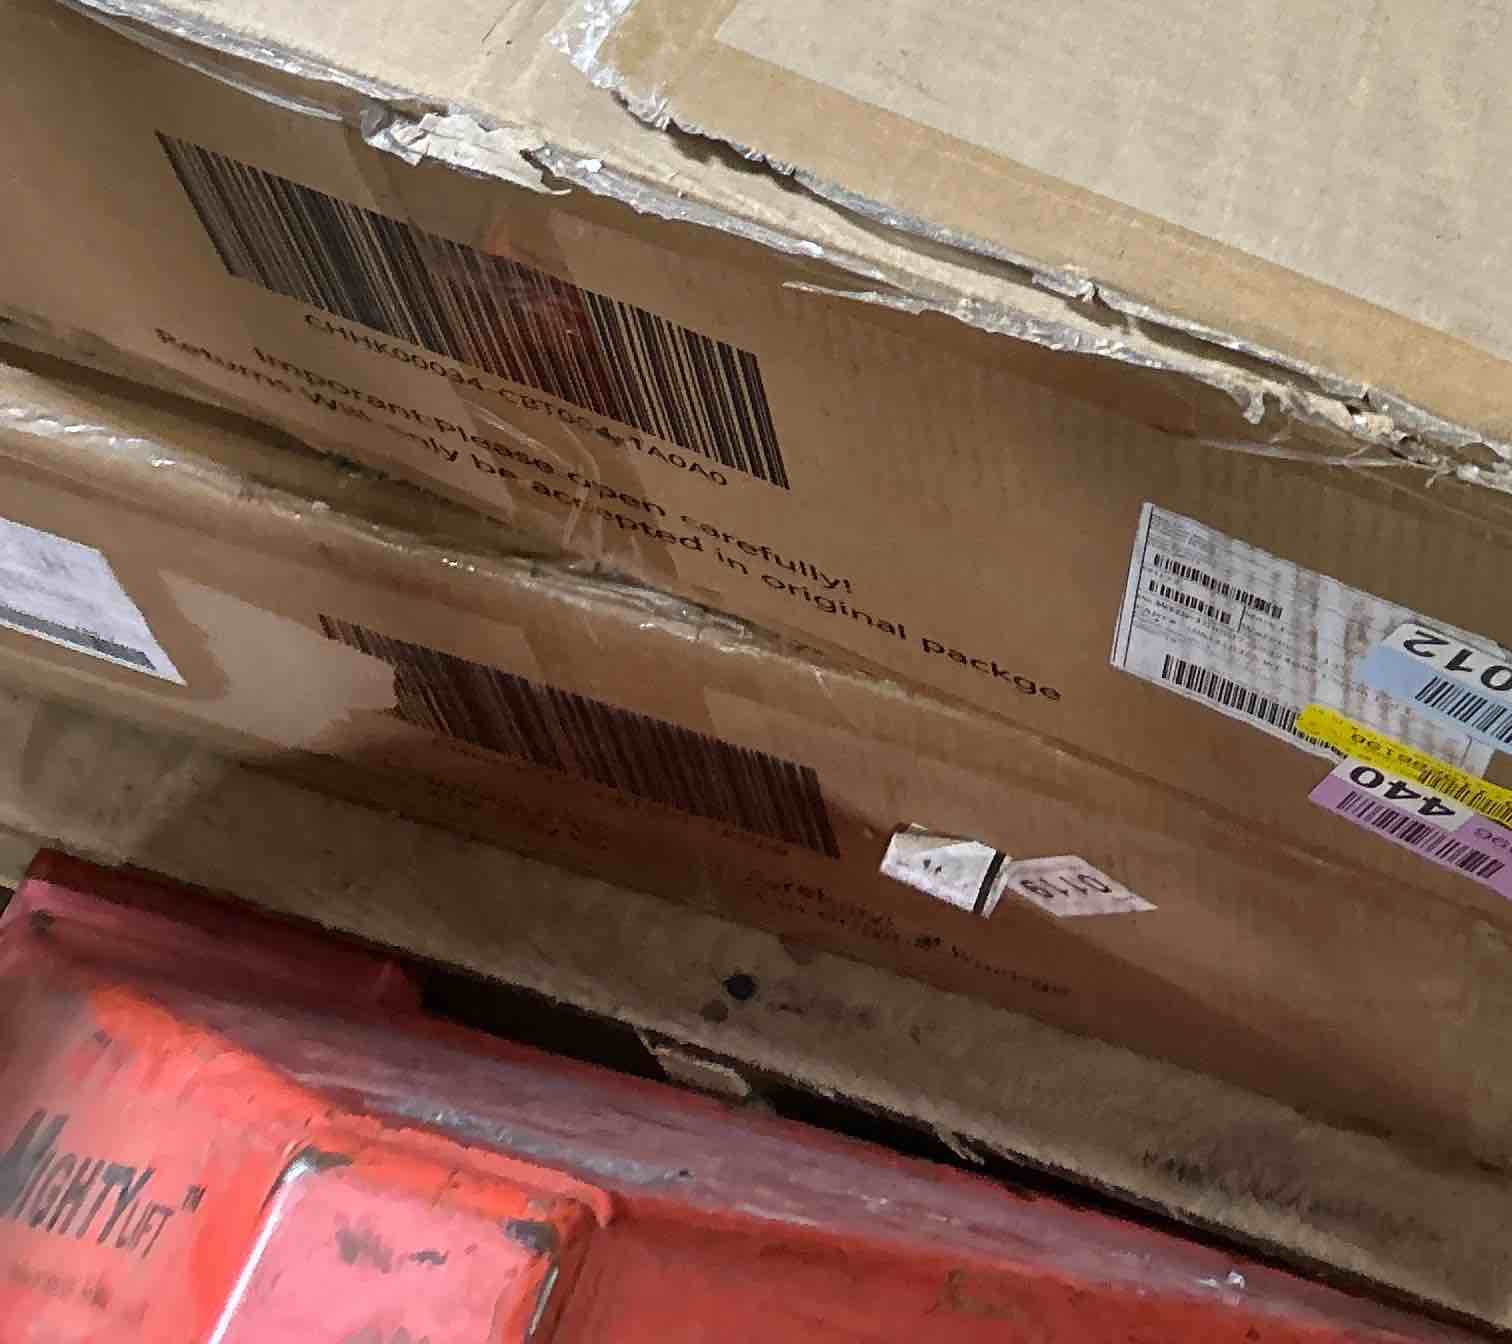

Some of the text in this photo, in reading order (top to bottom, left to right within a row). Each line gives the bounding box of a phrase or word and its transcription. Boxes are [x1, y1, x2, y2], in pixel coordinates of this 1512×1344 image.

[470, 452, 518, 480] be
[714, 547, 749, 575] in
[759, 573, 908, 640] original
[920, 635, 1062, 702] packge
[1349, 763, 1457, 818] 440
[1019, 873, 1113, 900] 0119
